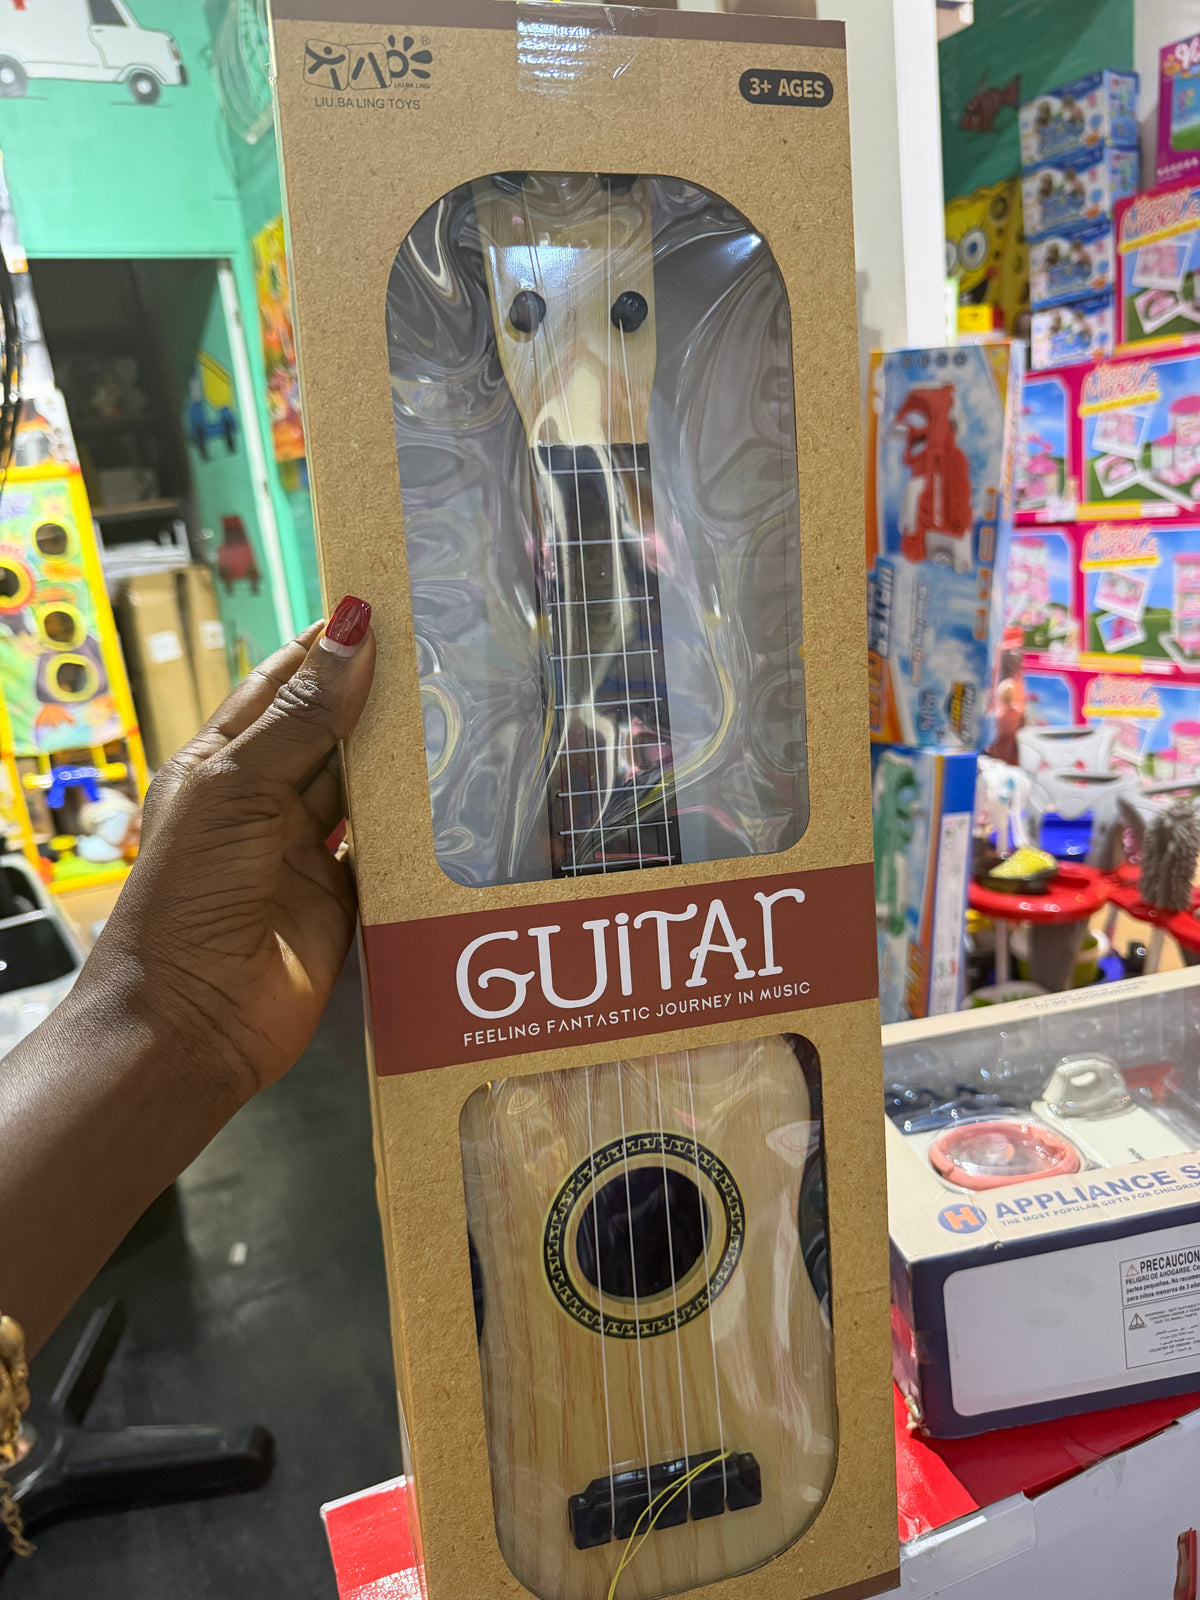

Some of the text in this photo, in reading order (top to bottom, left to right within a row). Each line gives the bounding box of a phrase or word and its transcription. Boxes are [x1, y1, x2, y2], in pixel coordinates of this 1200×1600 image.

[749, 77, 825, 99] 3+ AGES
[314, 97, 421, 110] LIU BA LING TOYS
[463, 981, 811, 1047] FEELING FANTASTIC JOURNEY IN MUSIC
[995, 1170, 1177, 1219] APPLIANCE
[943, 1206, 981, 1230] H
[1000, 1217, 1021, 1227] THE
[1022, 1211, 1051, 1222] MOST
[1053, 1203, 1100, 1216] POPULAR
[1100, 1196, 1130, 1207] GIFTS
[1131, 1191, 1152, 1200] FOR
[1125, 1274, 1150, 1286] PELIGRO
[1150, 1272, 1159, 1280] DE
[1179, 1274, 1200, 1282] recome
[1126, 1295, 1139, 1303] para
[1155, 1287, 1179, 1296] menores
